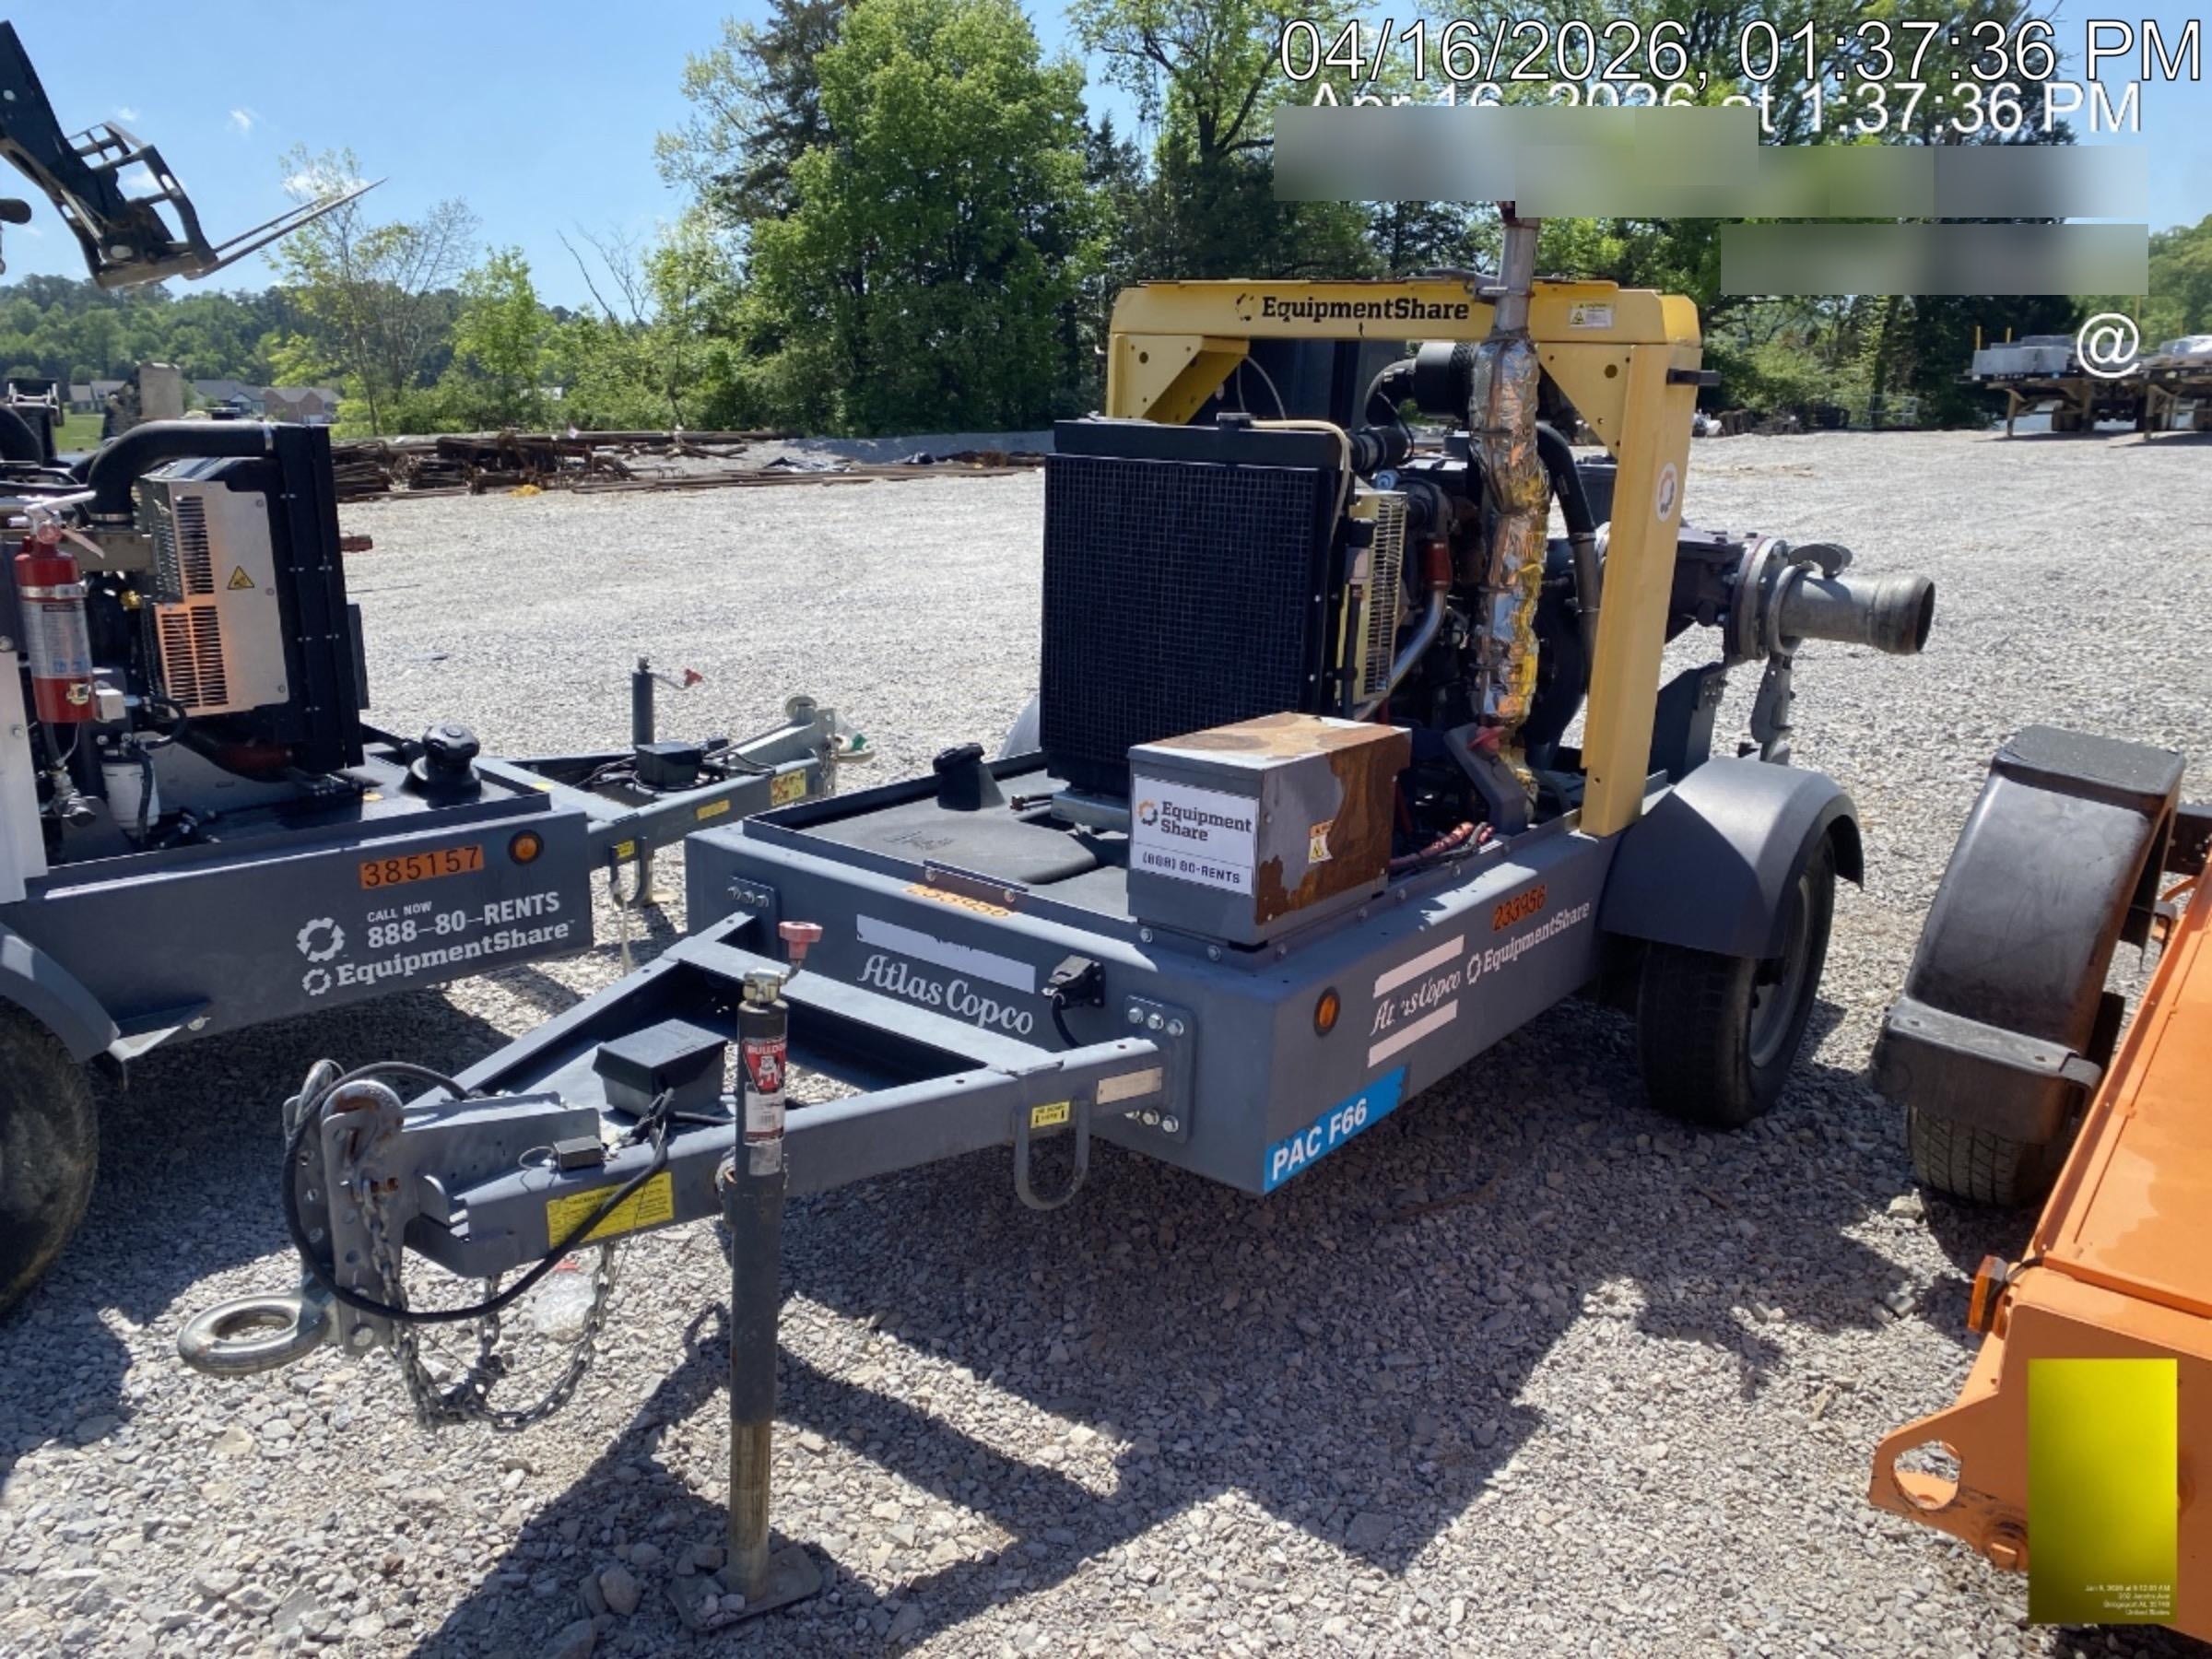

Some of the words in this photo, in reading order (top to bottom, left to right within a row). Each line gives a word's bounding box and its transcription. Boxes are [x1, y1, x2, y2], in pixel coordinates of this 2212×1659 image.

[1261, 296, 1469, 323] EquipmentShare
[1160, 818, 1208, 841] Share
[1161, 801, 1253, 833] Equipment
[363, 846, 479, 888] 385157
[1180, 860, 1241, 884] 80-RENTS
[367, 908, 398, 923] CALL
[403, 900, 432, 915] NOW
[368, 891, 560, 948] 888-80-RENTS
[336, 923, 570, 986] EquipmentShare
[1484, 901, 1590, 973] EquipmentShare
[857, 954, 943, 1005] Atlas
[946, 979, 1033, 1035] Copco
[1272, 1125, 1322, 1181] PAC
[1329, 1098, 1367, 1145] F66
